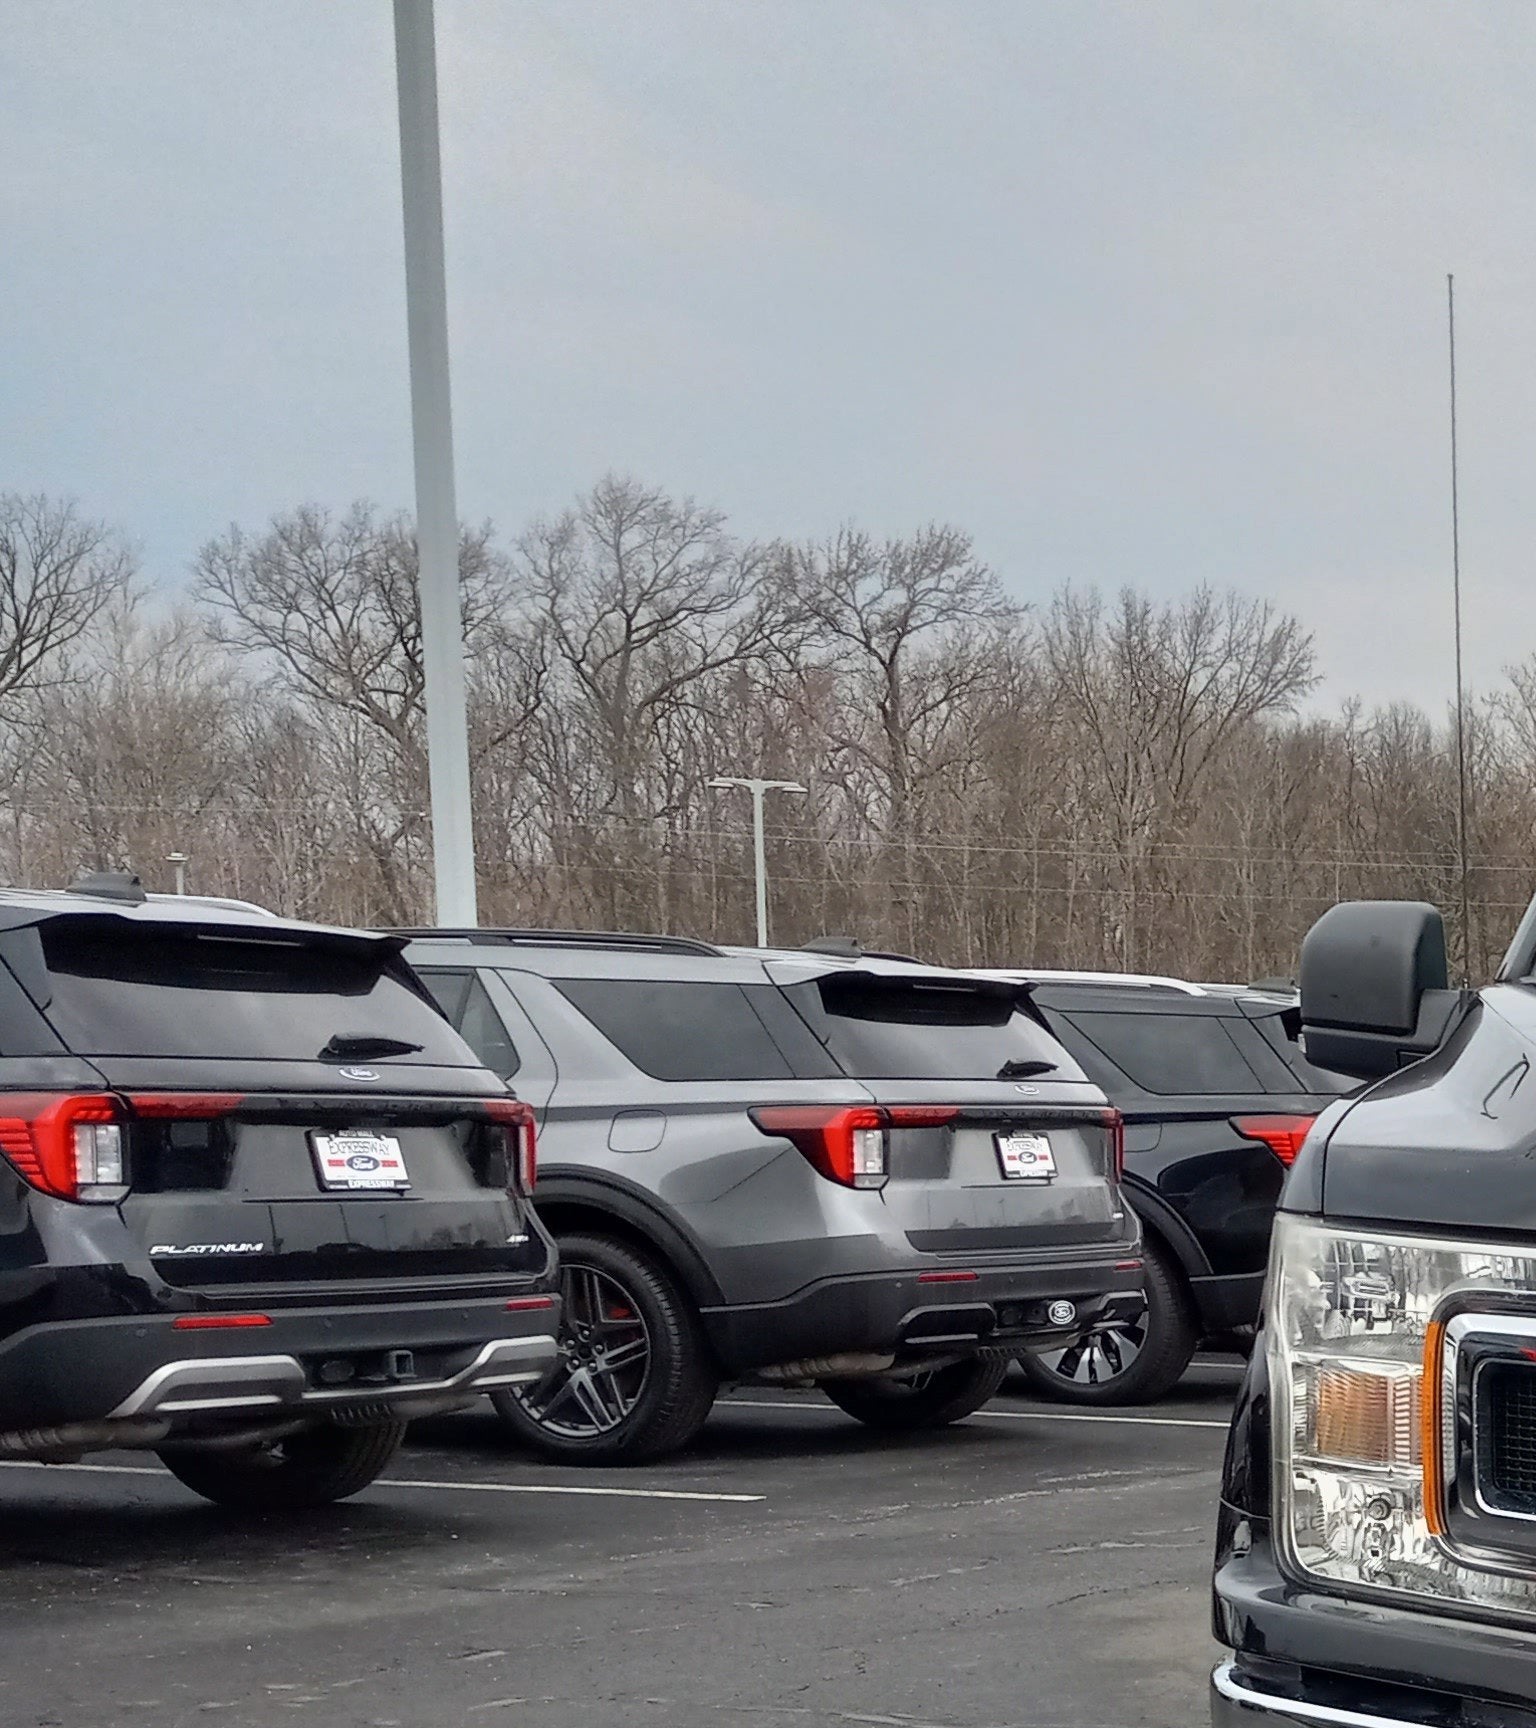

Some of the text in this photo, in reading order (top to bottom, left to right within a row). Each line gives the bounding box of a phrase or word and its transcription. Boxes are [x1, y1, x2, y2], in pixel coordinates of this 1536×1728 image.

[328, 1139, 390, 1155] EXPRESSWAY
[351, 1157, 375, 1169] Ford
[149, 1242, 264, 1255] PLATINUM
